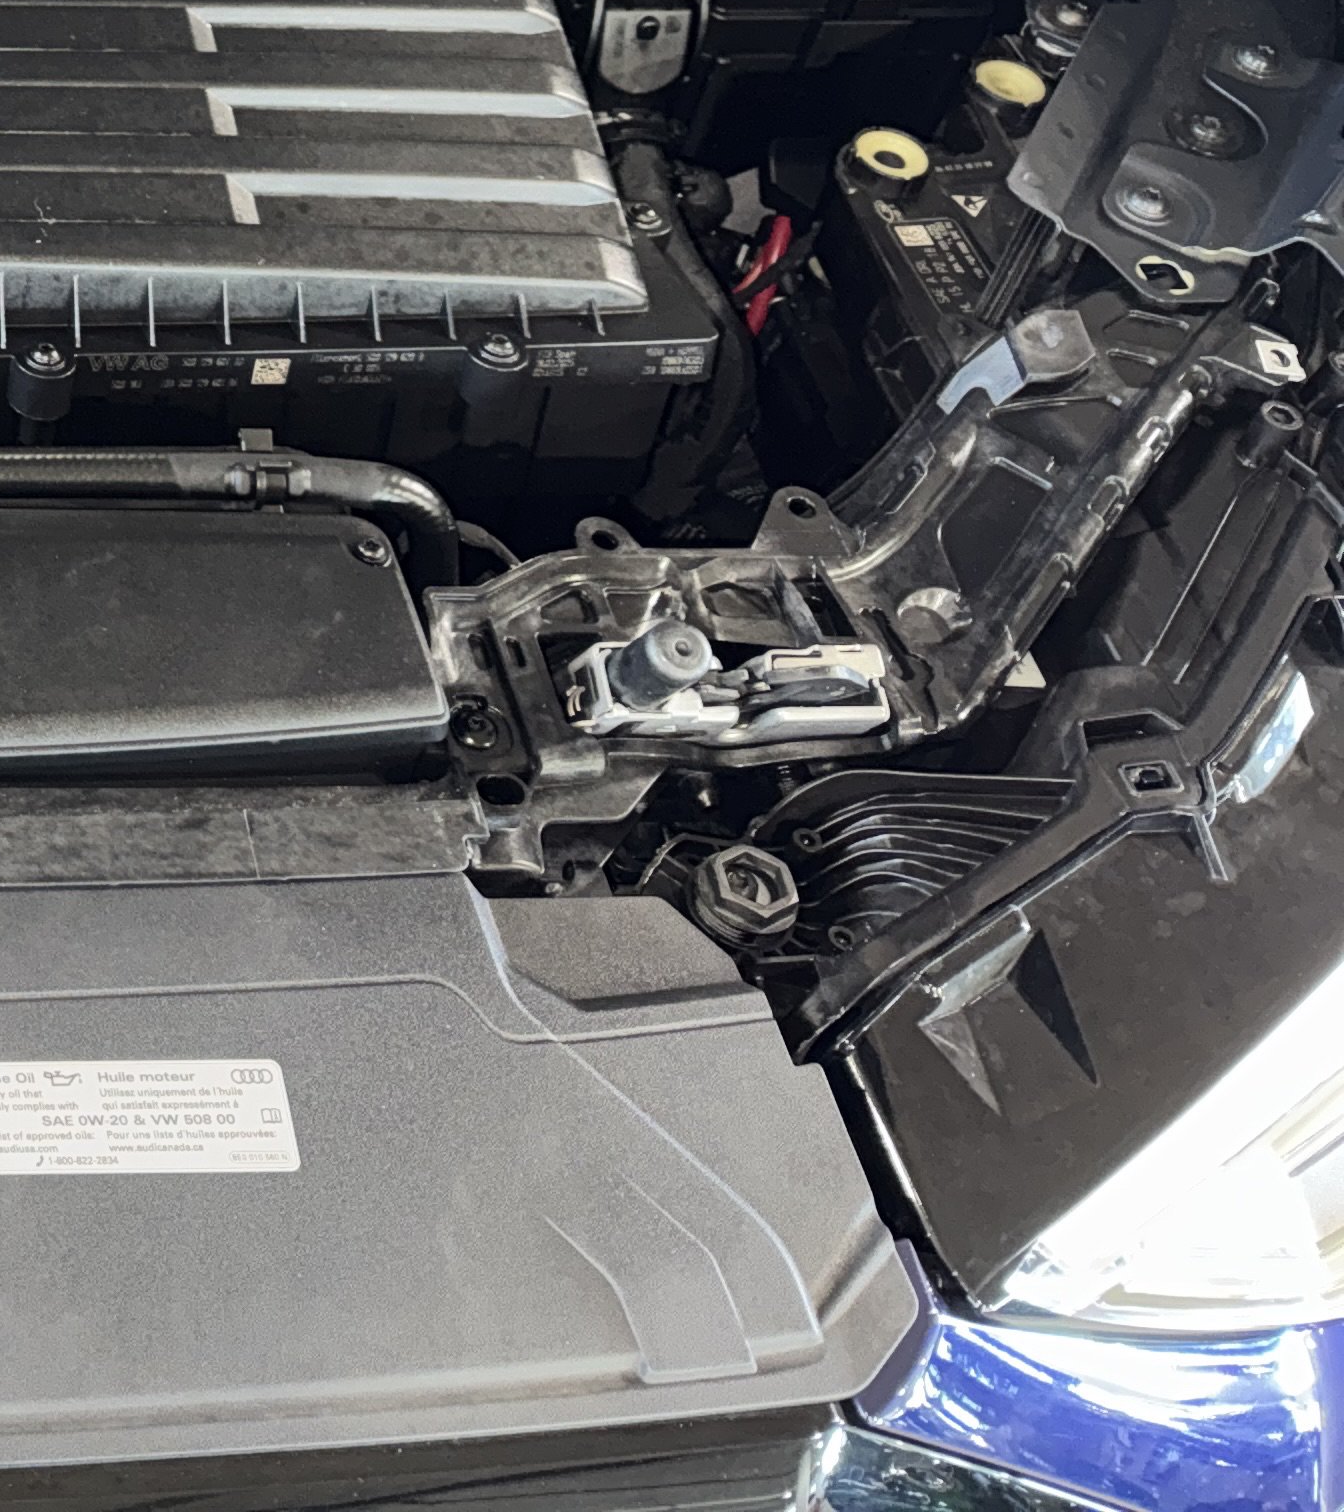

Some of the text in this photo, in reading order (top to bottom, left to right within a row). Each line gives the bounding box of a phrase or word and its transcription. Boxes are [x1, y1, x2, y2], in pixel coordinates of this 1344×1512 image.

[15, 1072, 35, 1084] Oil
[97, 1071, 135, 1083] Huile
[139, 1071, 196, 1083] moteur
[8, 1090, 21, 1098] oil
[23, 1089, 42, 1098] that
[99, 1088, 135, 1097] Utilisez
[138, 1088, 196, 1098] uniquement
[199, 1087, 211, 1096] de
[12, 1101, 55, 1112] complies
[57, 1101, 79, 1111] with
[102, 1101, 118, 1111] qui
[120, 1100, 159, 1109] satisfait
[42, 1113, 236, 1127] SAE 0W-20 & VW 508 00
[12, 1131, 23, 1140] of
[26, 1131, 72, 1142] approved
[106, 1130, 130, 1139] Pour
[132, 1131, 150, 1139] une
[153, 1129, 174, 1139] liste
[108, 1143, 205, 1152] www.audicanada.ca
